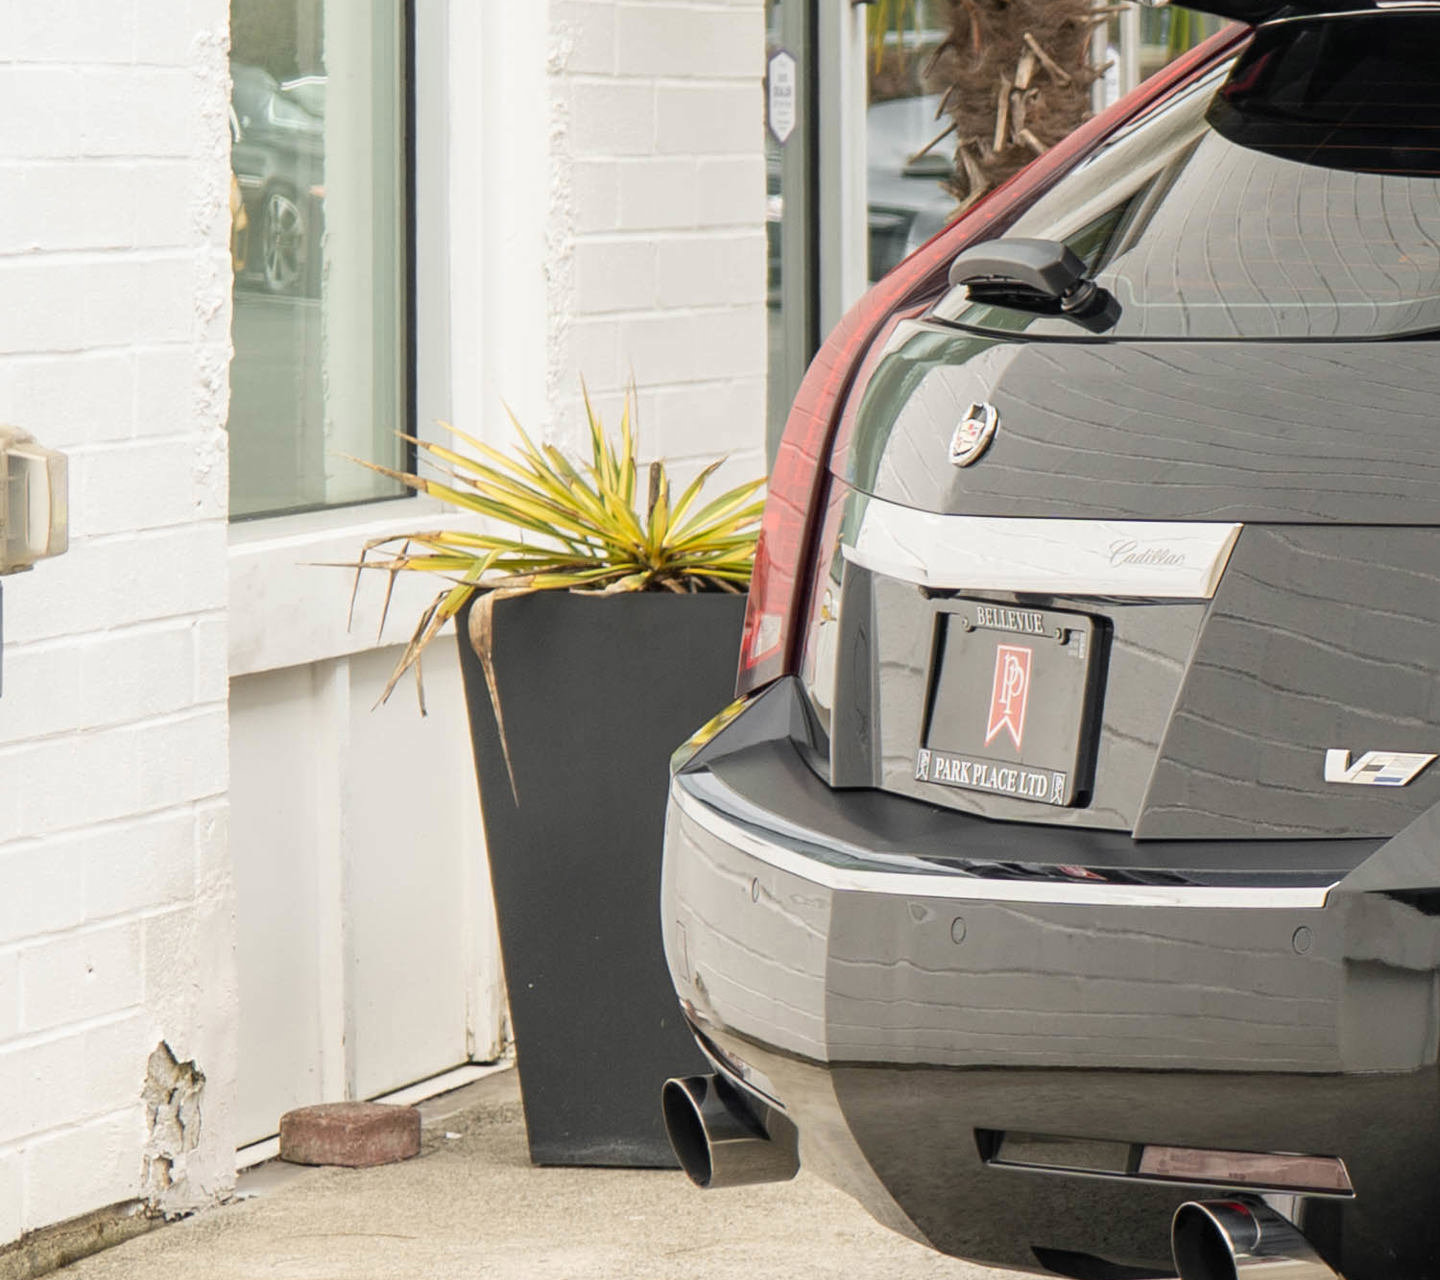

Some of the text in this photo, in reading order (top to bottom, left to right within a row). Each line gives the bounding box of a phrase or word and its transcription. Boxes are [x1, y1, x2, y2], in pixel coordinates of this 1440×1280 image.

[1108, 539, 1186, 569] Cadillac
[976, 606, 1045, 633] BELLEVUE
[934, 757, 972, 785] PARK
[972, 763, 1018, 793] PLACE
[1019, 771, 1048, 798] LTD
